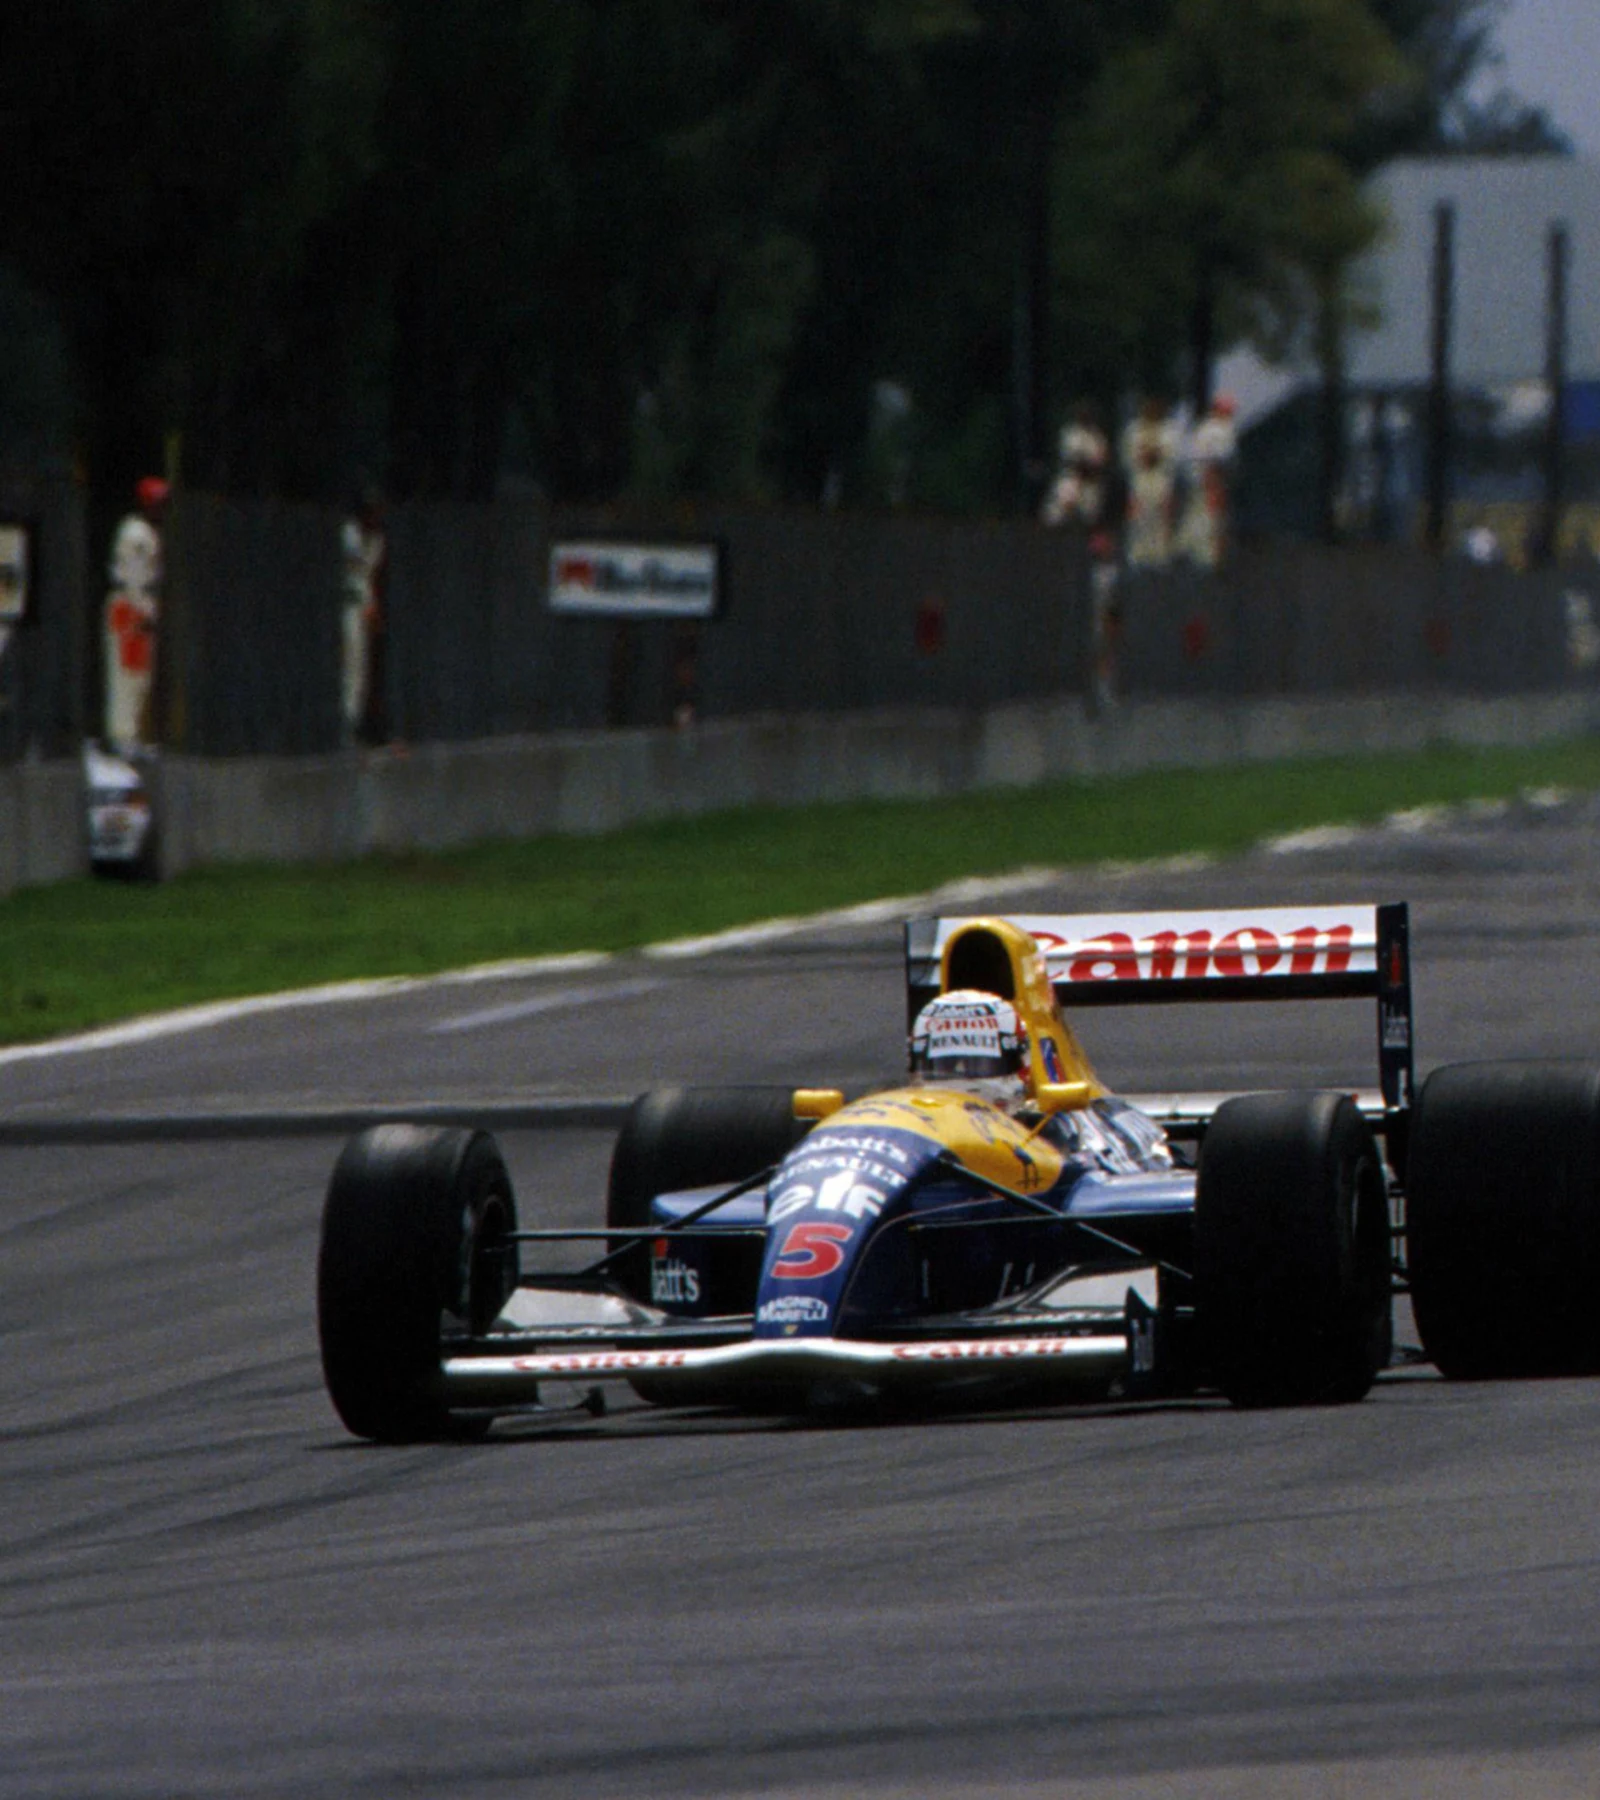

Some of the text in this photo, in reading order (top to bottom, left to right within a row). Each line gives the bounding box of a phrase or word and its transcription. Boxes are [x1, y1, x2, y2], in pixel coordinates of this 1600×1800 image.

[925, 1017, 998, 1031] Canon
[931, 1034, 998, 1049] RENAULT
[768, 1155, 908, 1190] RENAULT
[770, 1222, 855, 1279] 5
[892, 1339, 1069, 1360] Canon
[512, 1352, 687, 1371] Canon
